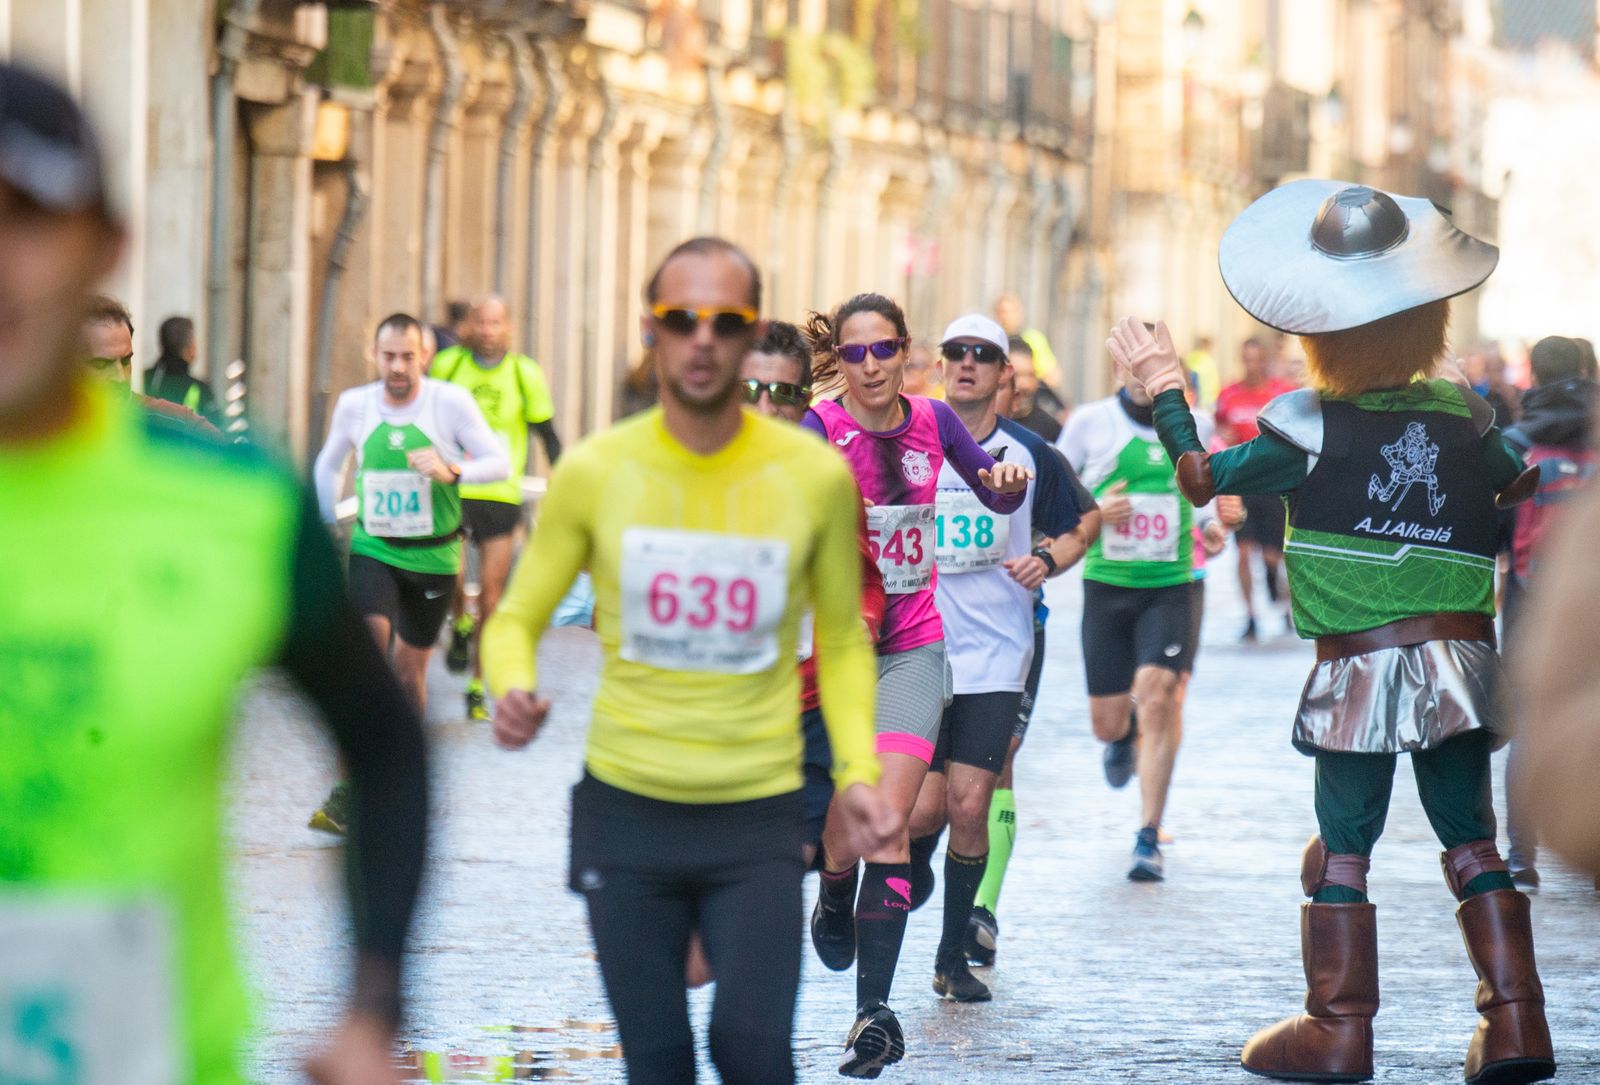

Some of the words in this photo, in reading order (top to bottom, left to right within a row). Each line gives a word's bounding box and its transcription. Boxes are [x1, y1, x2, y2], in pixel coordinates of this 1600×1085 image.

[373, 490, 420, 516] 204
[935, 514, 994, 549] 138
[1114, 513, 1168, 541] 499
[1353, 517, 1453, 543] A.J.Alkalá
[868, 528, 924, 567] 543
[648, 571, 759, 635] 639
